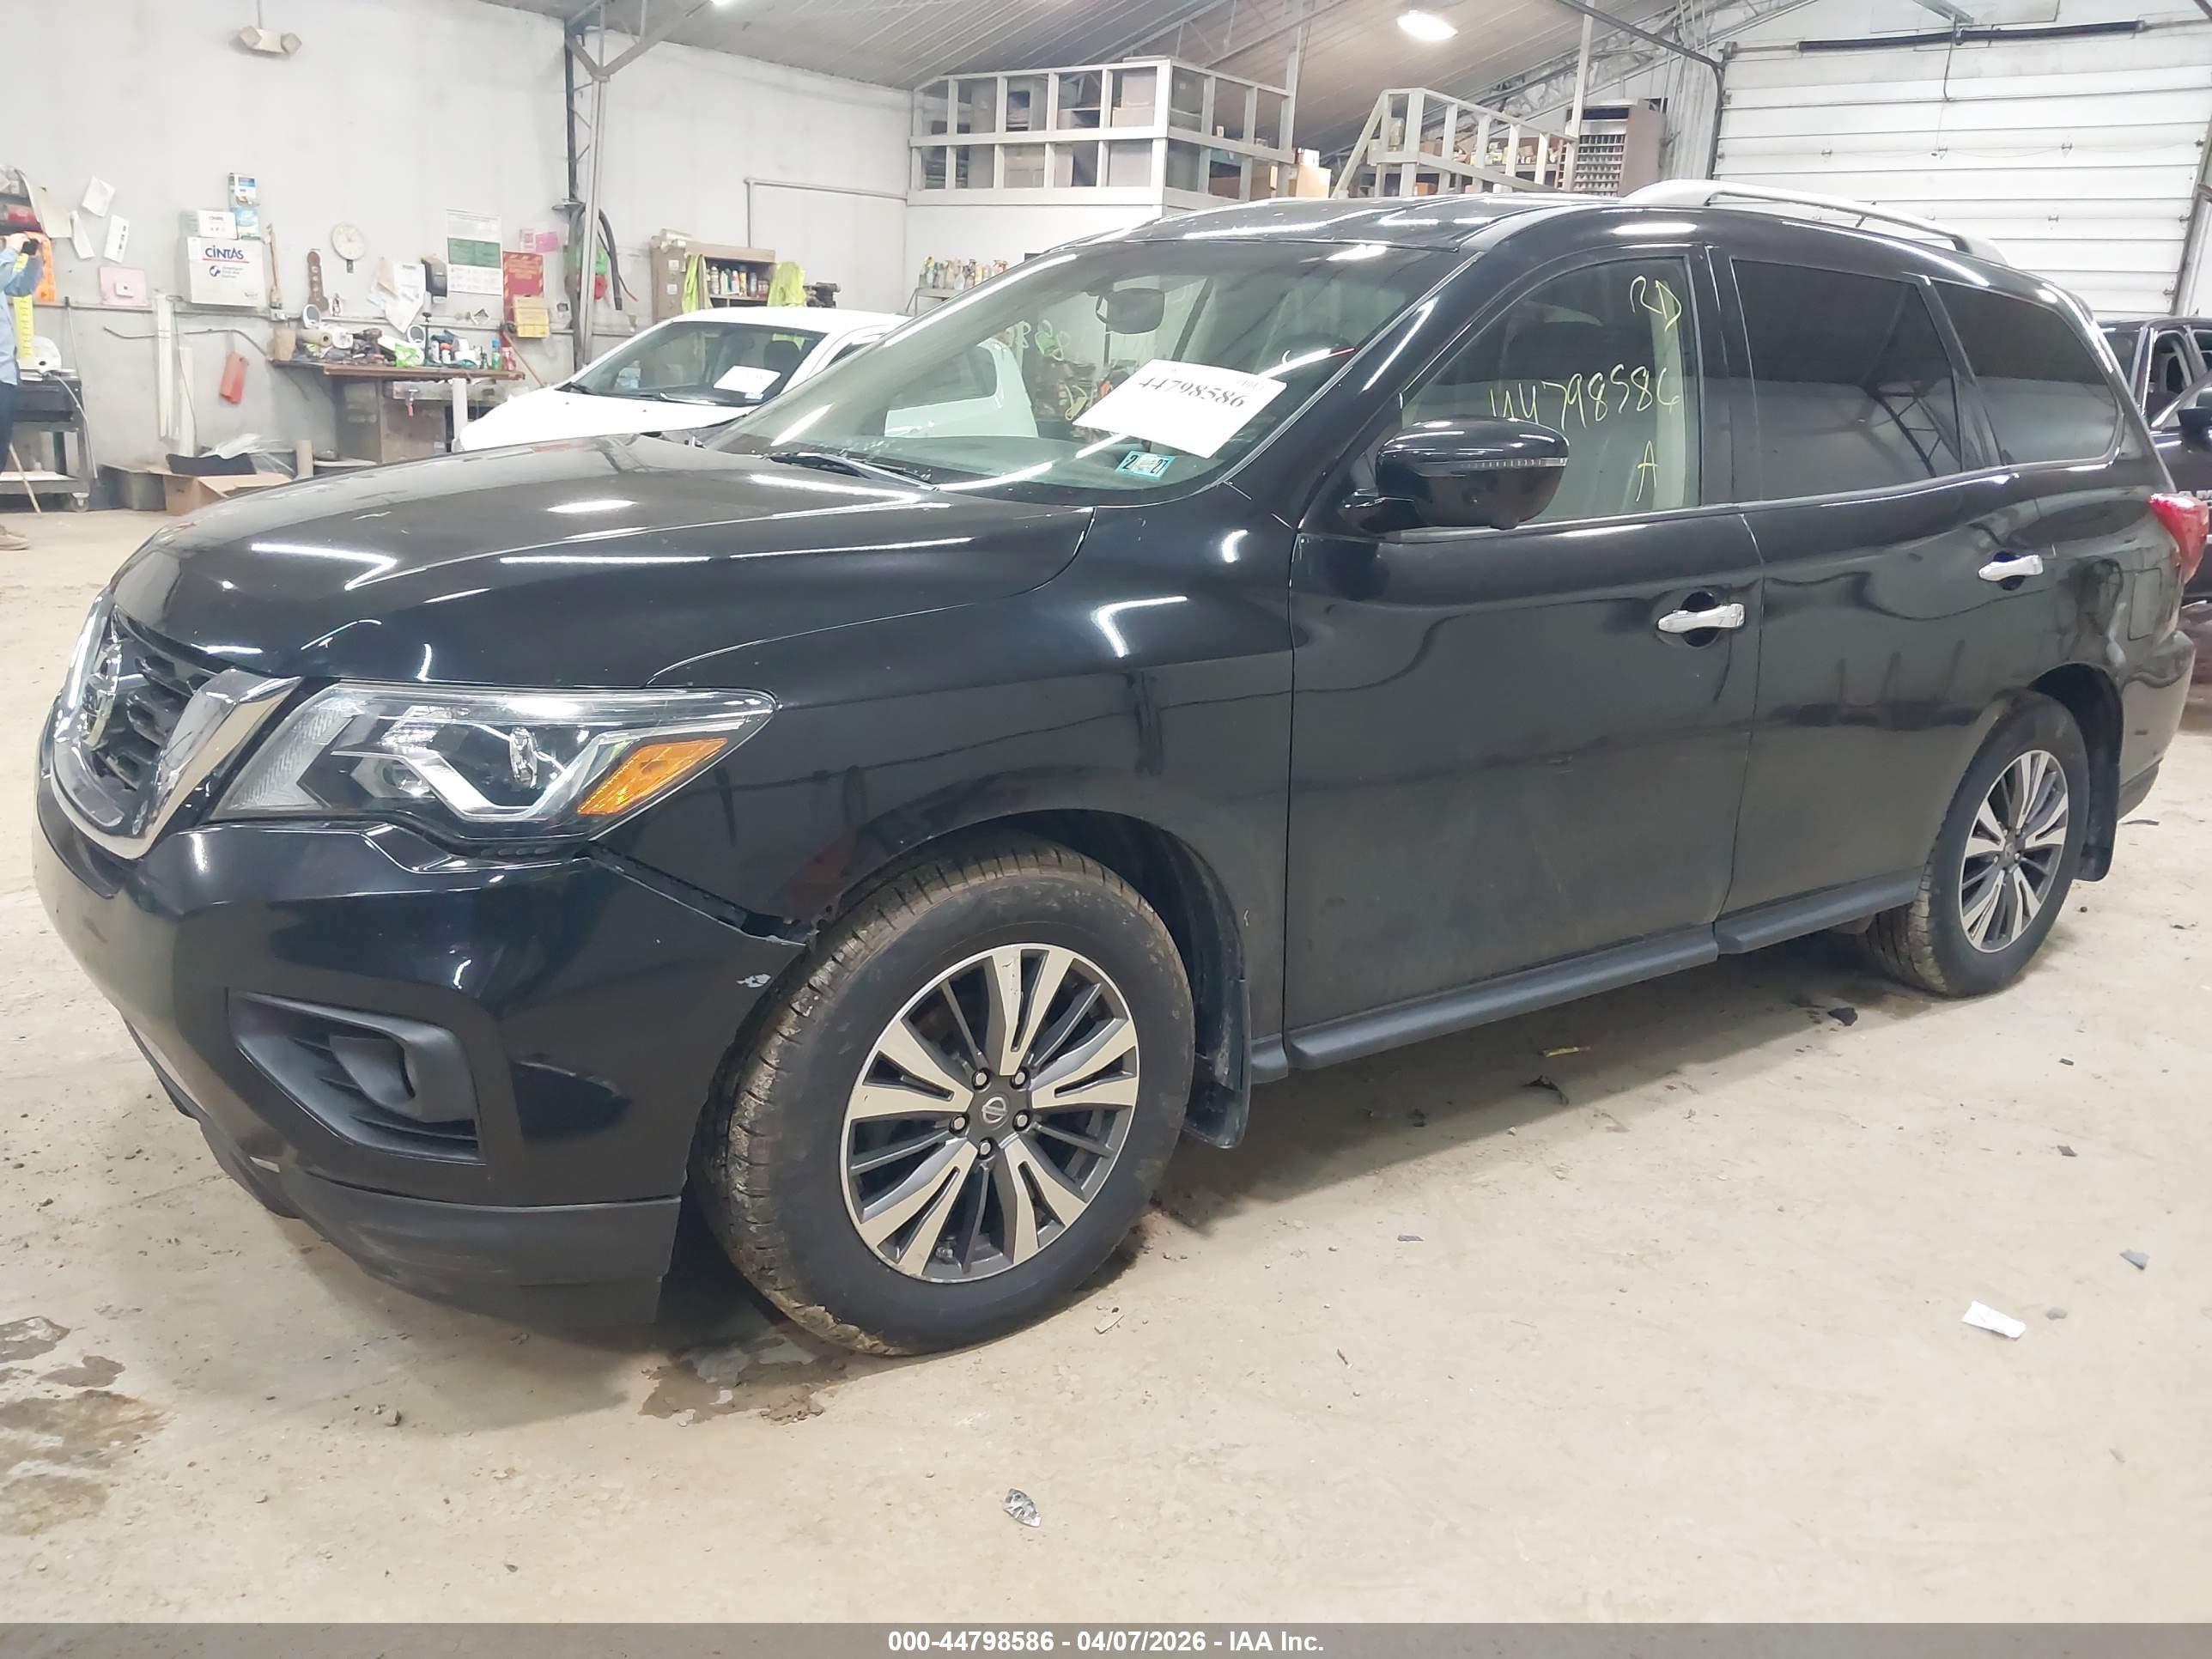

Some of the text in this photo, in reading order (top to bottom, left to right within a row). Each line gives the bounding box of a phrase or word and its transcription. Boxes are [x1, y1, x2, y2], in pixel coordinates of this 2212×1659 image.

[1137, 377, 1248, 408] 44798586
[1122, 454, 1139, 470] 2
[1150, 459, 1170, 474] 27
[1635, 440, 1659, 502] A
